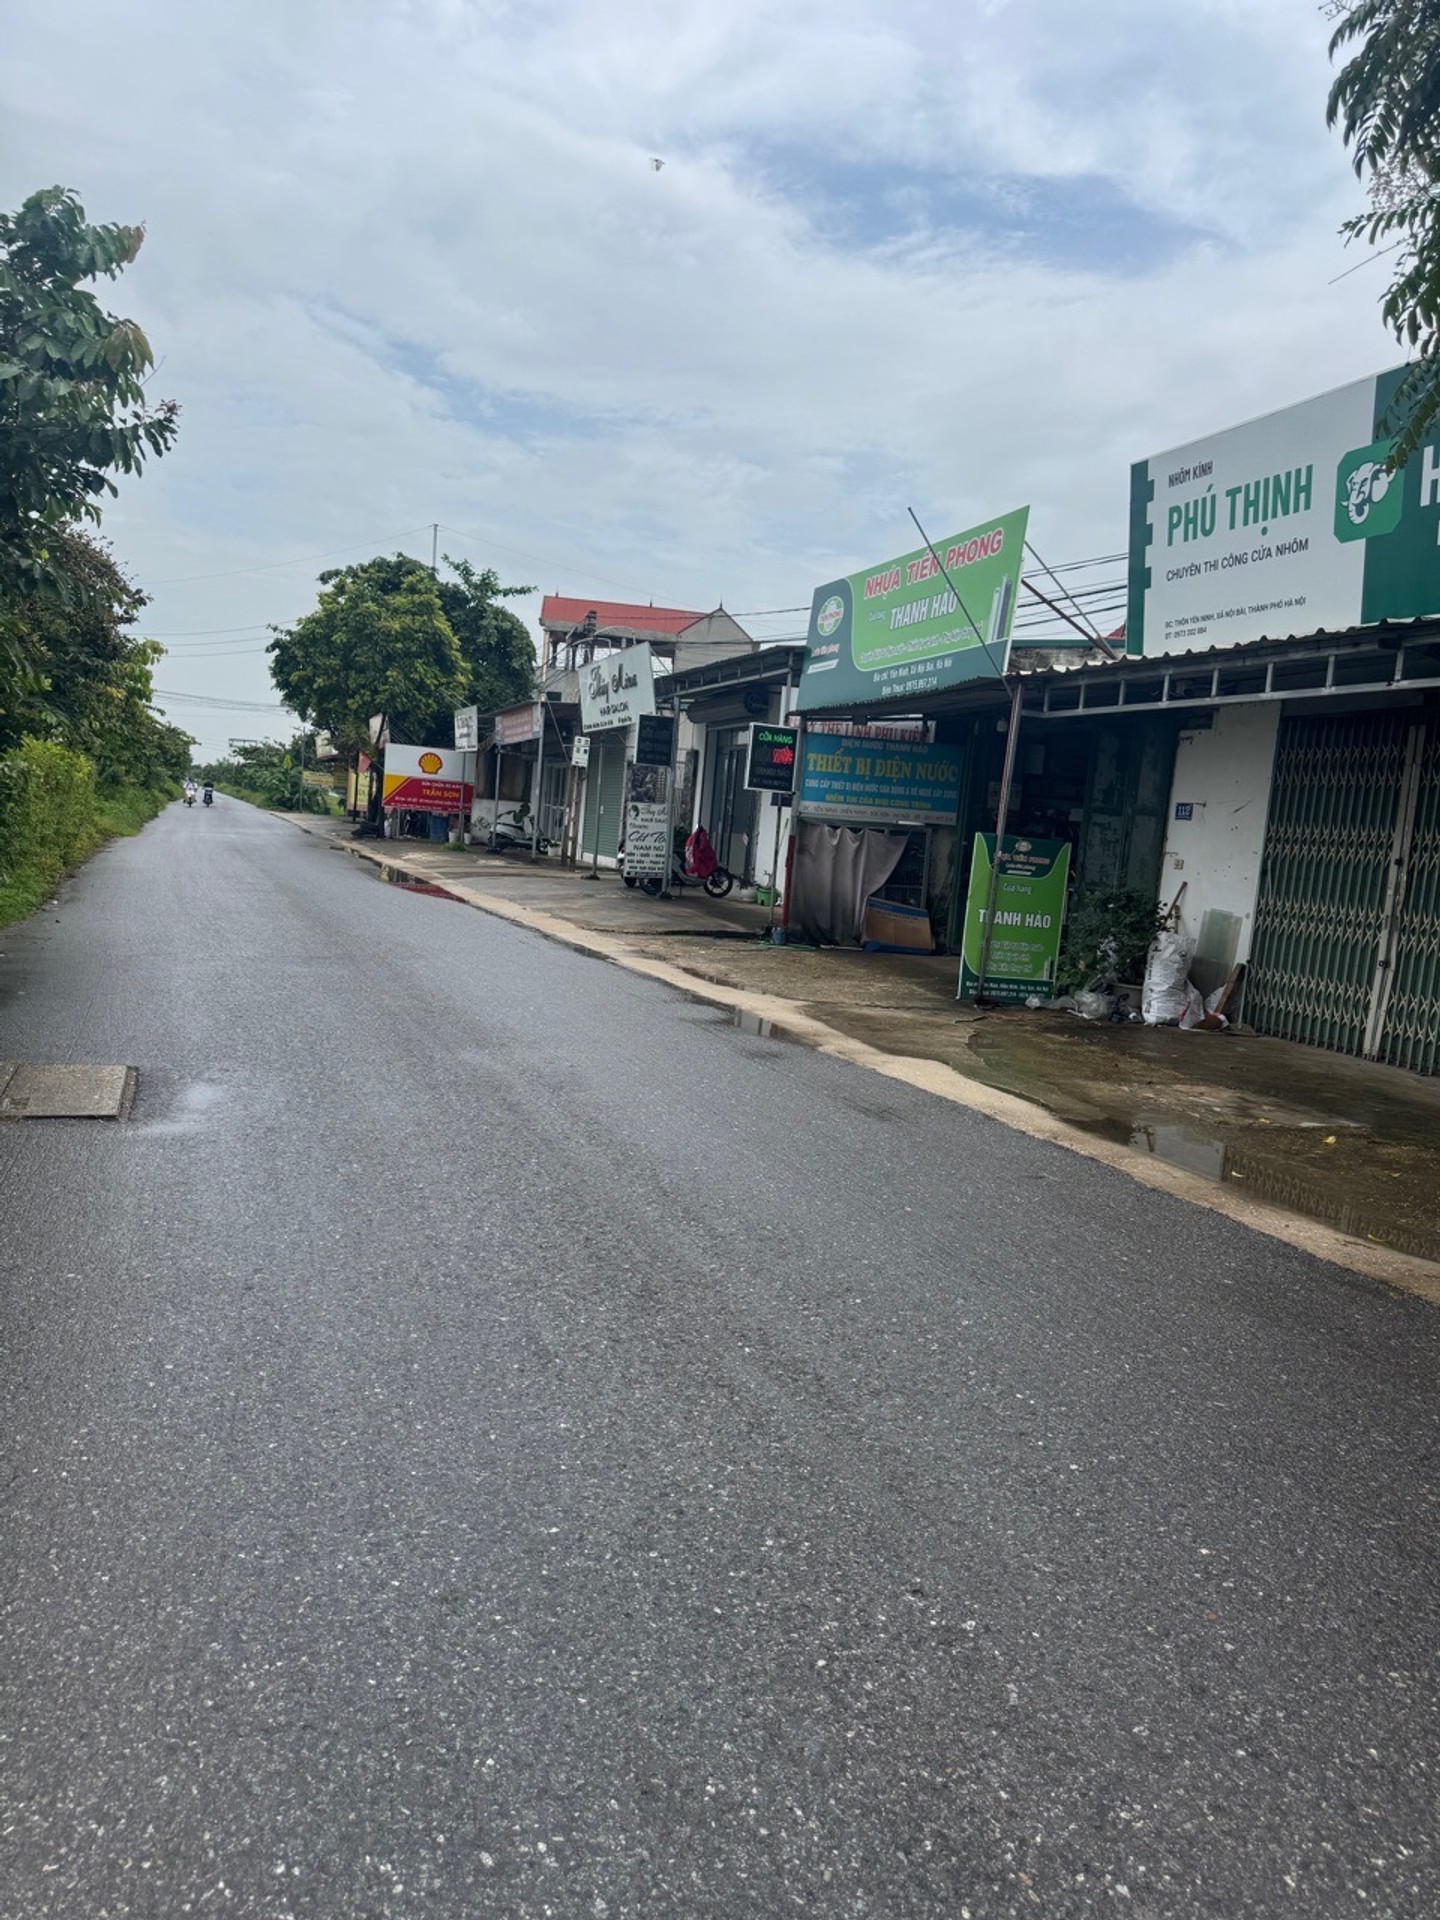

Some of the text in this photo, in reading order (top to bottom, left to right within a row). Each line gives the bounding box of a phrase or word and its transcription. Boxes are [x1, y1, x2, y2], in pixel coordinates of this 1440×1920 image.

[1168, 460, 1213, 488] NHÔM KÍNH
[1167, 464, 1313, 546] PHÚ THỊNH
[864, 528, 1004, 599] NHỰA TIỀN PHONG
[1166, 537, 1309, 581] CHUYÊN THI CÔNG CỬA NHÔM
[889, 584, 959, 630] THANH HẢO
[1248, 603, 1269, 614] THÀNH
[1269, 598, 1283, 610] PHỐ
[1284, 597, 1293, 608] HÀ
[1294, 596, 1306, 607] NỘI
[806, 747, 852, 773] THIẾT
[855, 757, 871, 780] BỊ
[874, 756, 912, 783] ĐIỆN
[916, 760, 958, 782] NƯỚC
[978, 909, 1051, 928] TANH HẢO
